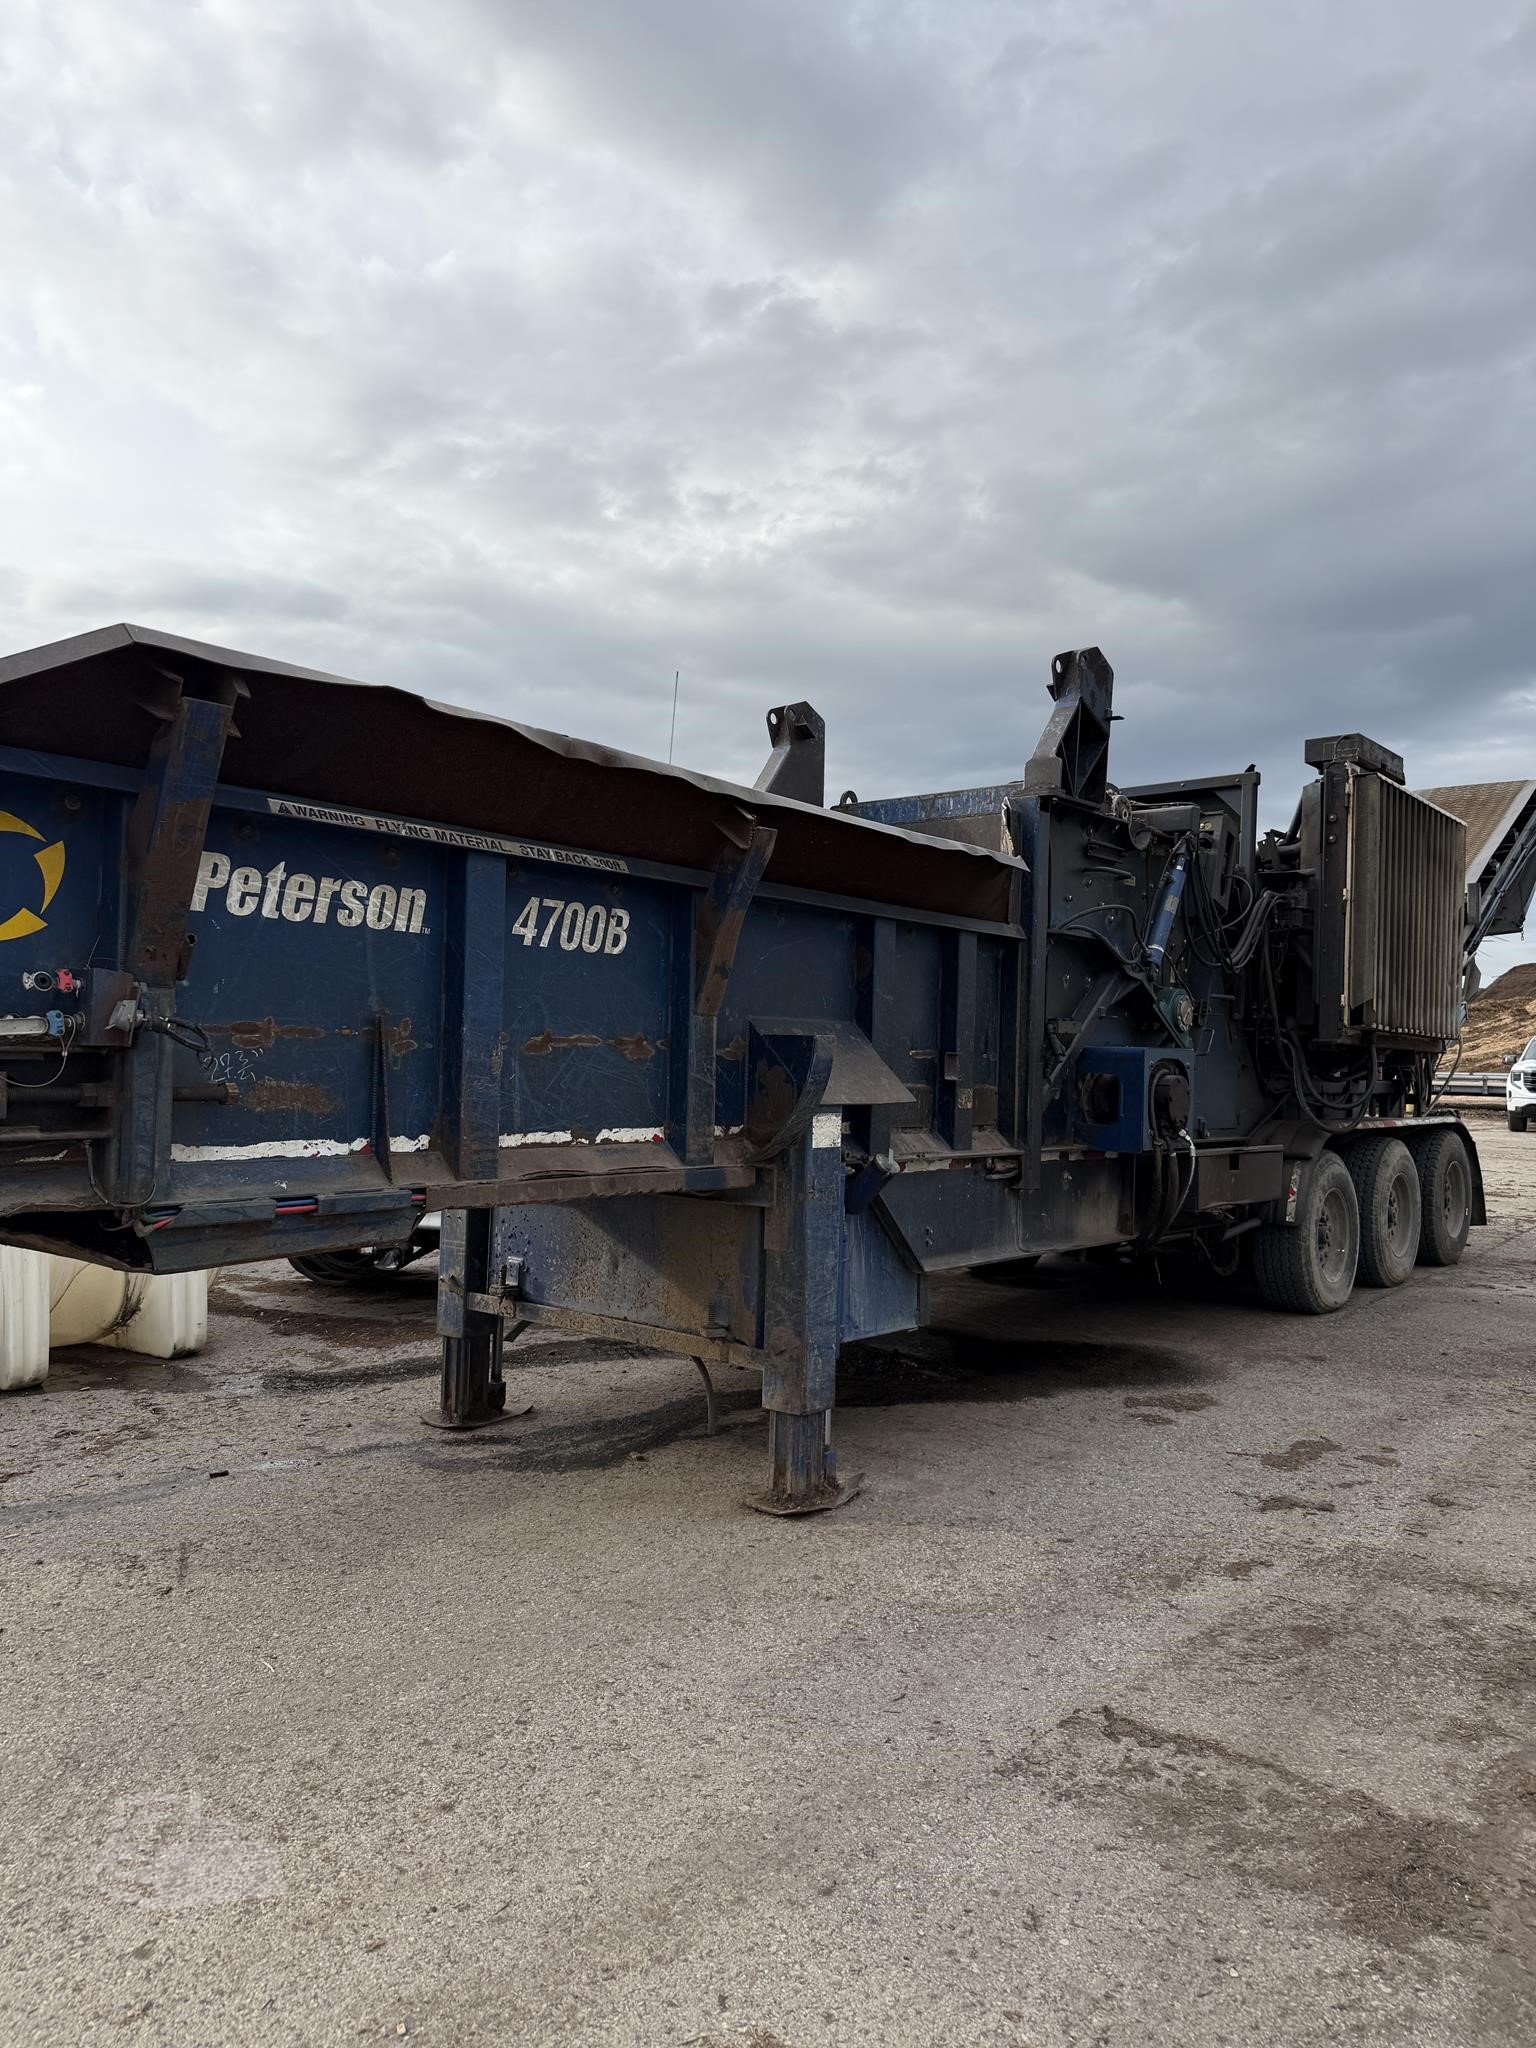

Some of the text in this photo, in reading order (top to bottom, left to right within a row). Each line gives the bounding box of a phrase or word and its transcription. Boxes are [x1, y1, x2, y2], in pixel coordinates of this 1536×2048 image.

[293, 804, 365, 827] WARNING
[519, 844, 552, 860] STAY
[556, 850, 592, 867] BACK
[190, 850, 427, 935] Peterson
[511, 896, 631, 955] 4700B
